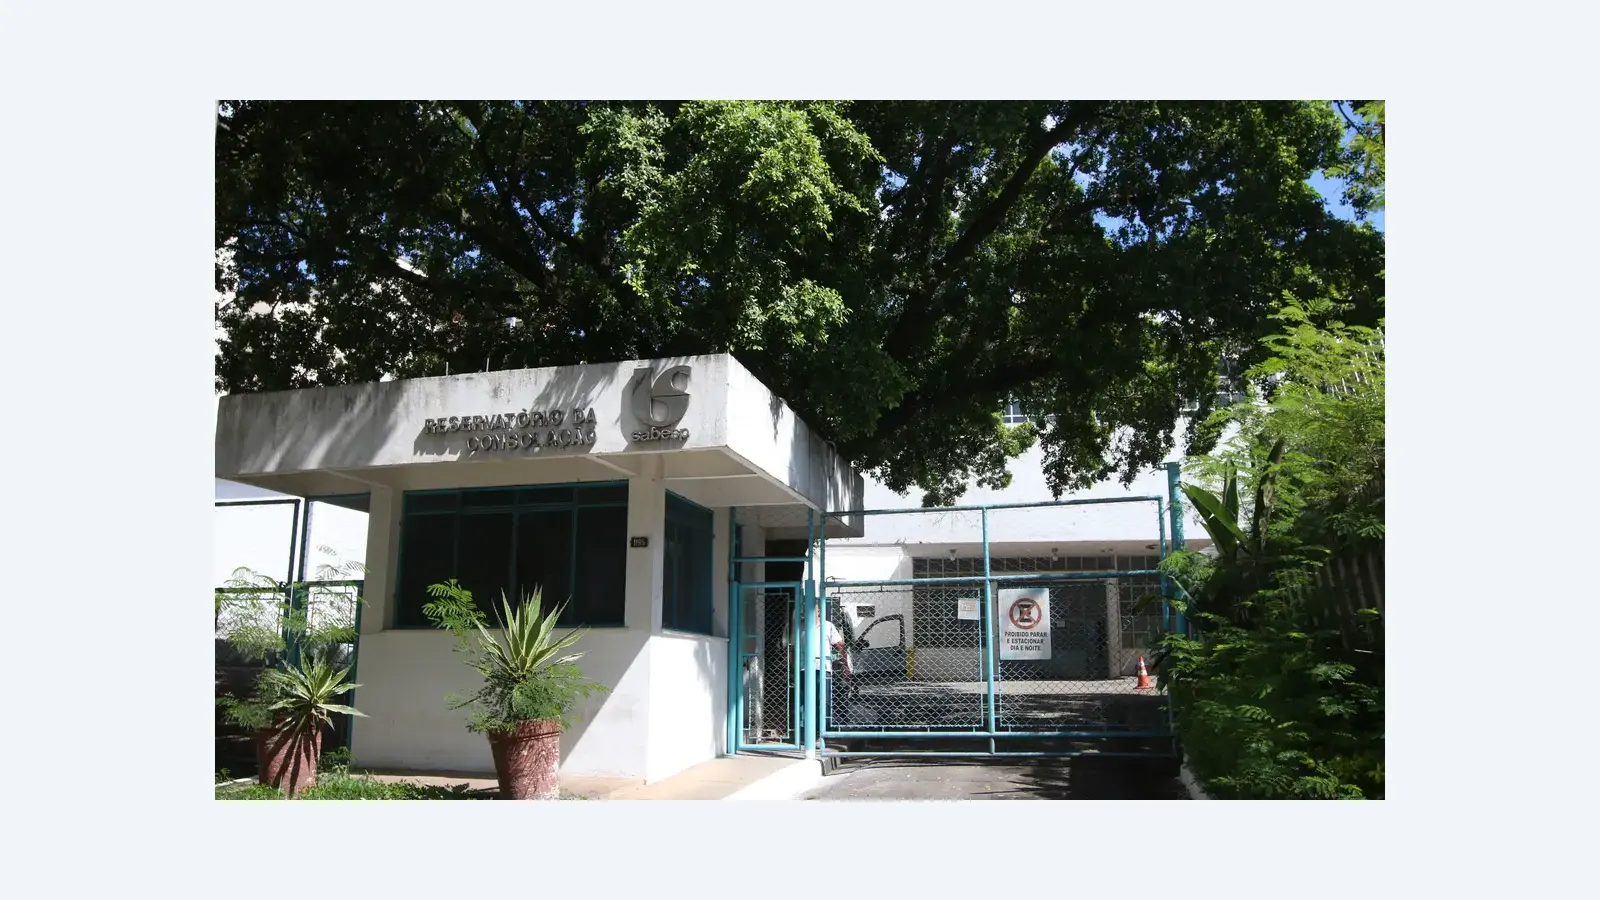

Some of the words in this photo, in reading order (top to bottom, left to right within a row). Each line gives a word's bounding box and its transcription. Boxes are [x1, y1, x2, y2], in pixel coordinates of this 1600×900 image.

[572, 407, 597, 425] DA
[466, 427, 597, 449] CONSOLAÇÃO
[631, 426, 690, 441] sabesp
